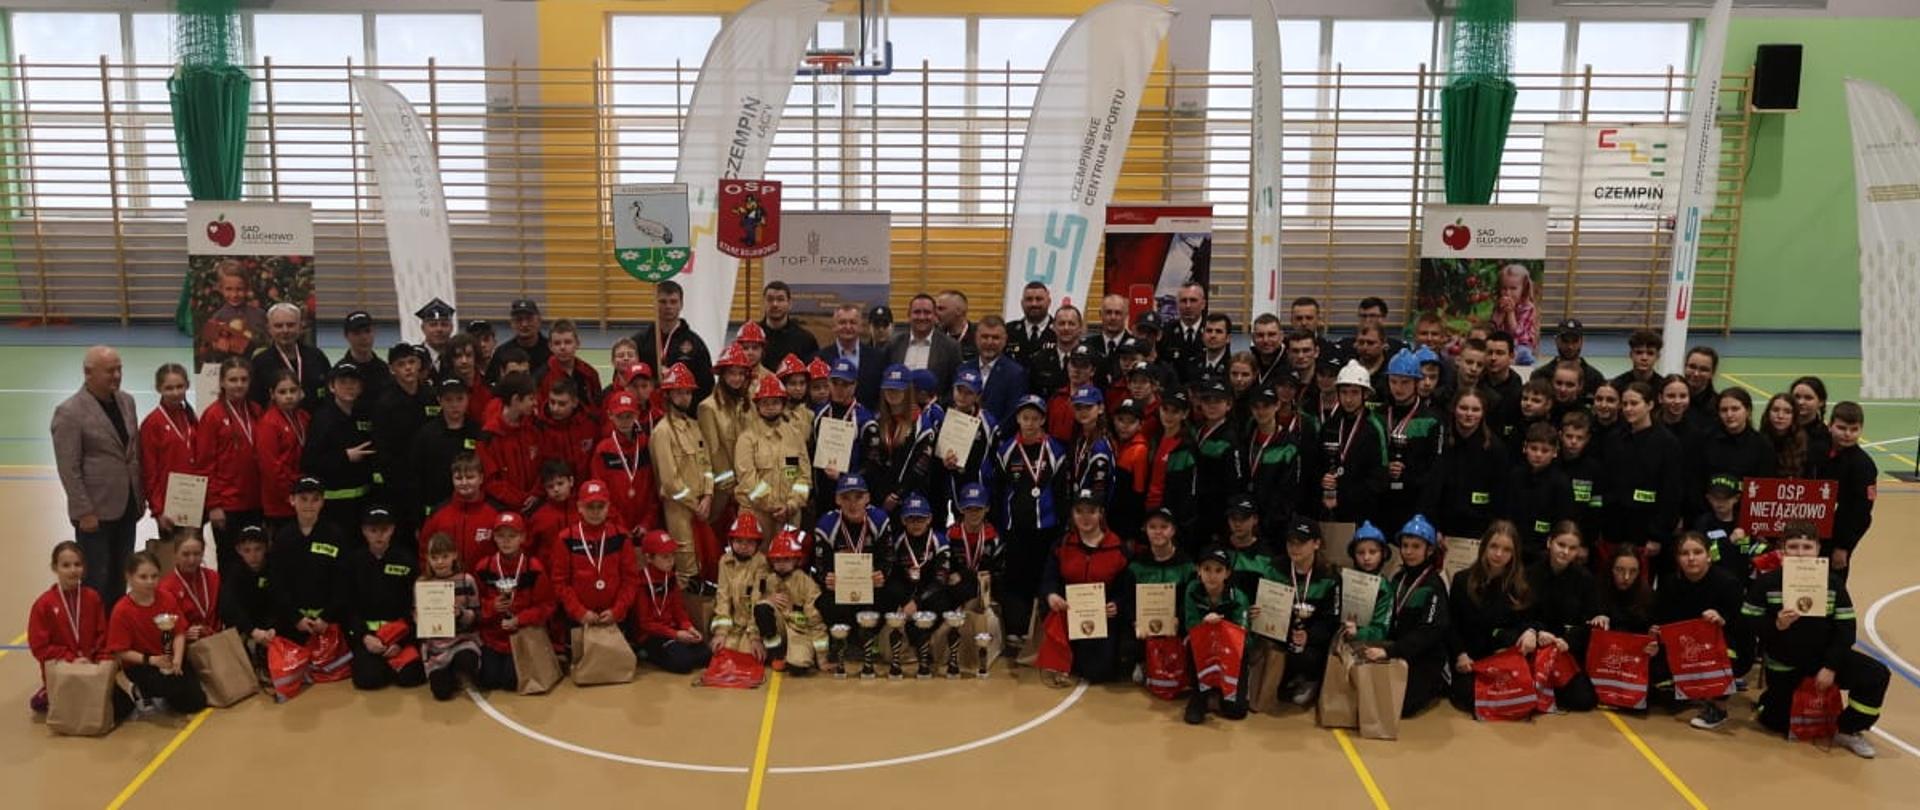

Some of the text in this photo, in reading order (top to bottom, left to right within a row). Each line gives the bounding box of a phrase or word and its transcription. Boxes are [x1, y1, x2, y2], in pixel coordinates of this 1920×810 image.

[725, 96, 761, 179] CZEMPIŃ
[1085, 89, 1126, 206] CENTRUM SPORTU
[725, 182, 776, 195] OSP
[1594, 184, 1664, 200] CZEMPIŃ
[1477, 229, 1496, 237] SAD
[779, 255, 869, 266] TOP FARMS
